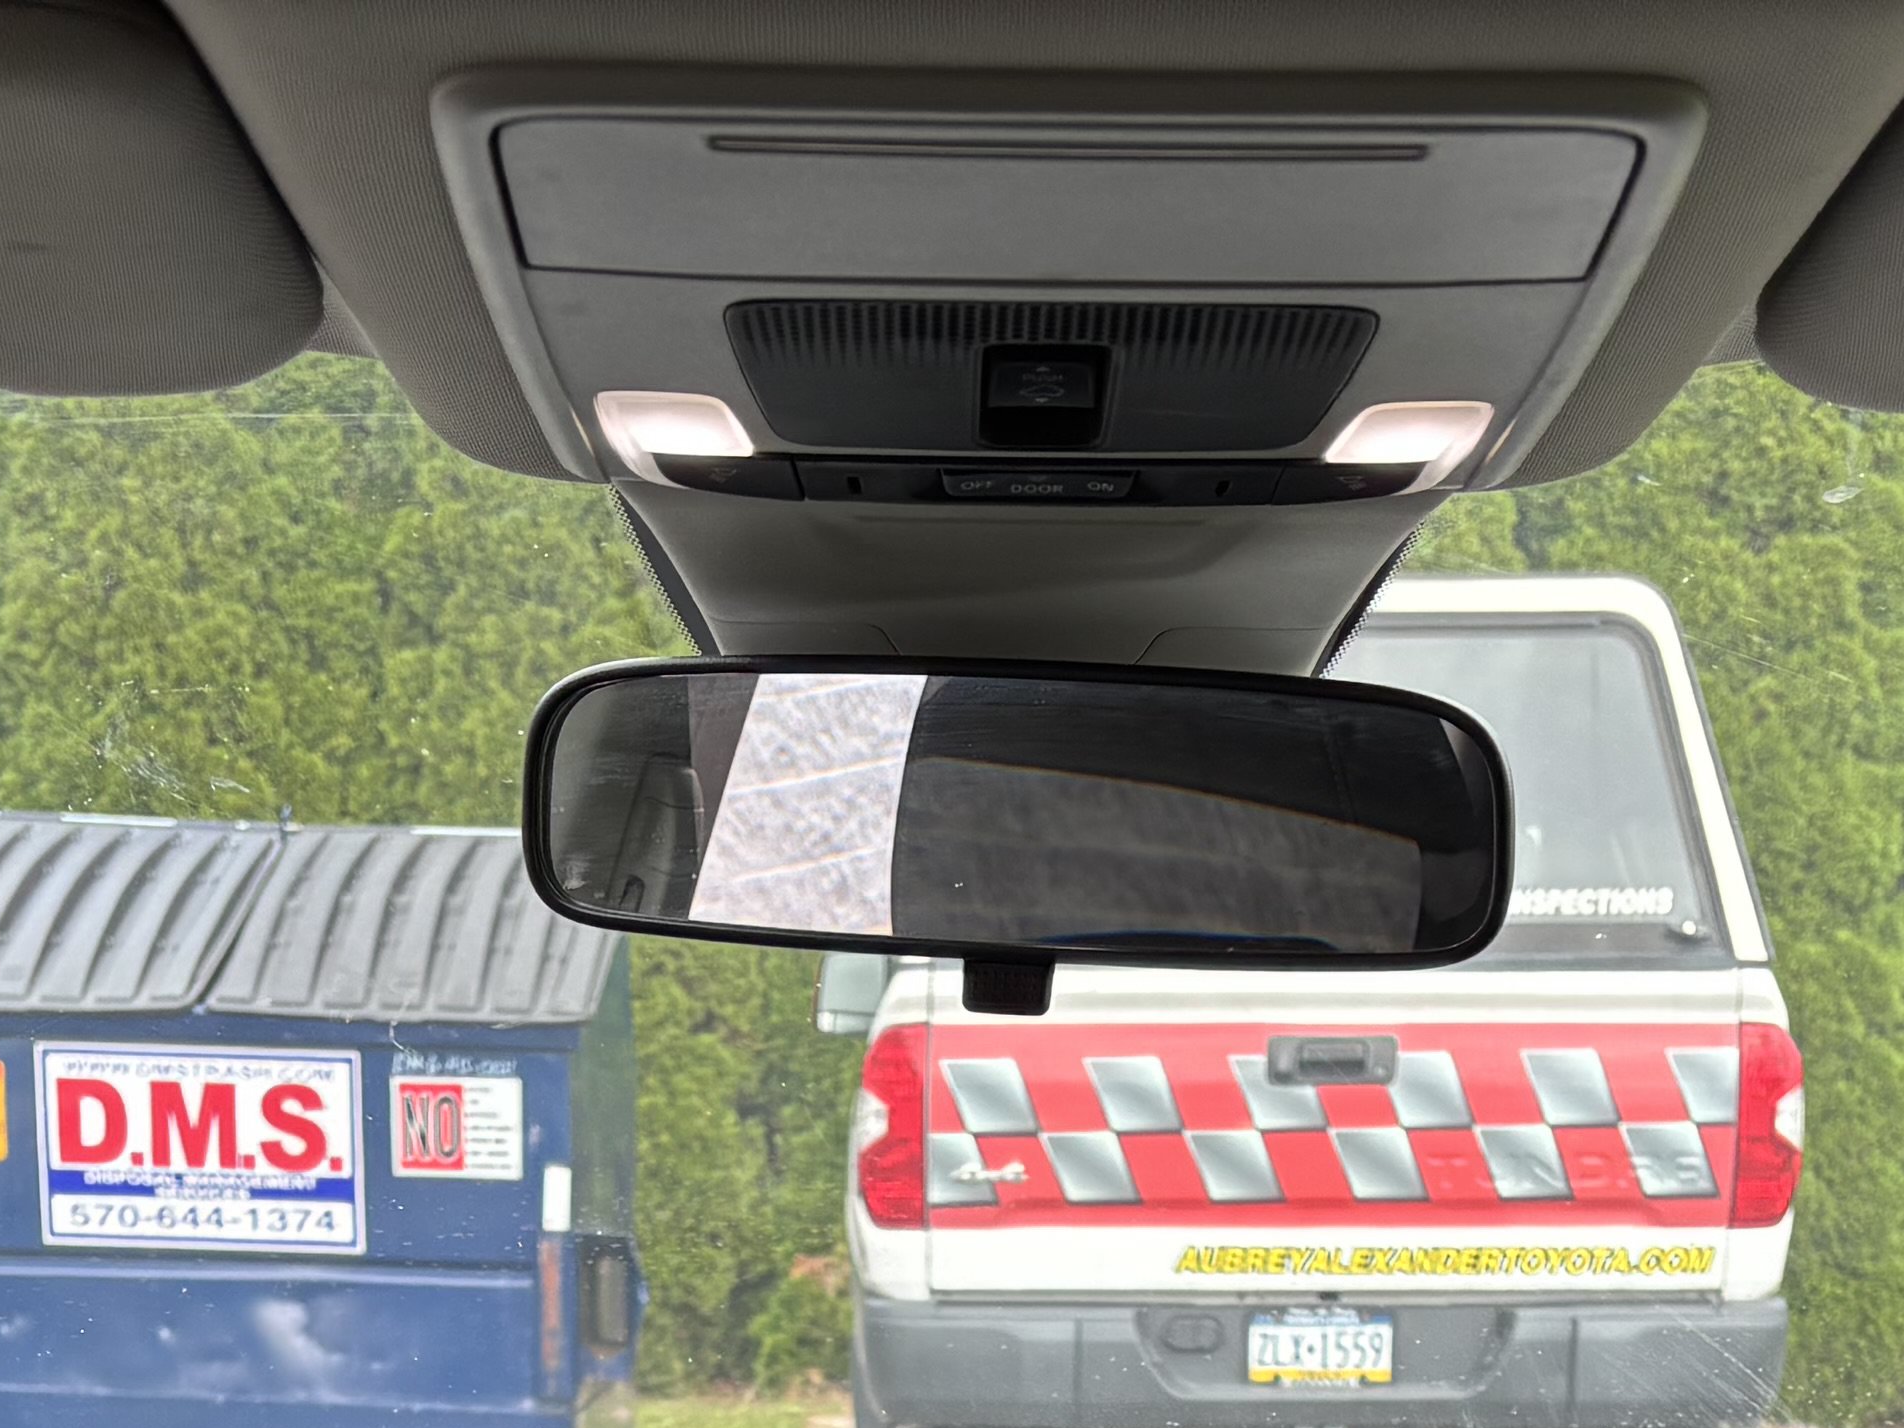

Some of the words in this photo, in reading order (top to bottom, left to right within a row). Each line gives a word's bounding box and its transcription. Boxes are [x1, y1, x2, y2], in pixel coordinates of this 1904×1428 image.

[960, 480, 992, 491] OFF
[1011, 484, 1064, 494] DOOR
[1087, 481, 1114, 492] ON
[1510, 886, 1674, 916] NSPECTIONS
[56, 1078, 344, 1174] D.M.S.
[402, 1092, 459, 1162] NO
[70, 1203, 336, 1233] 570-644-1374
[1173, 1247, 1715, 1276] AUBREYALEXANDERTOYOTA.COM
